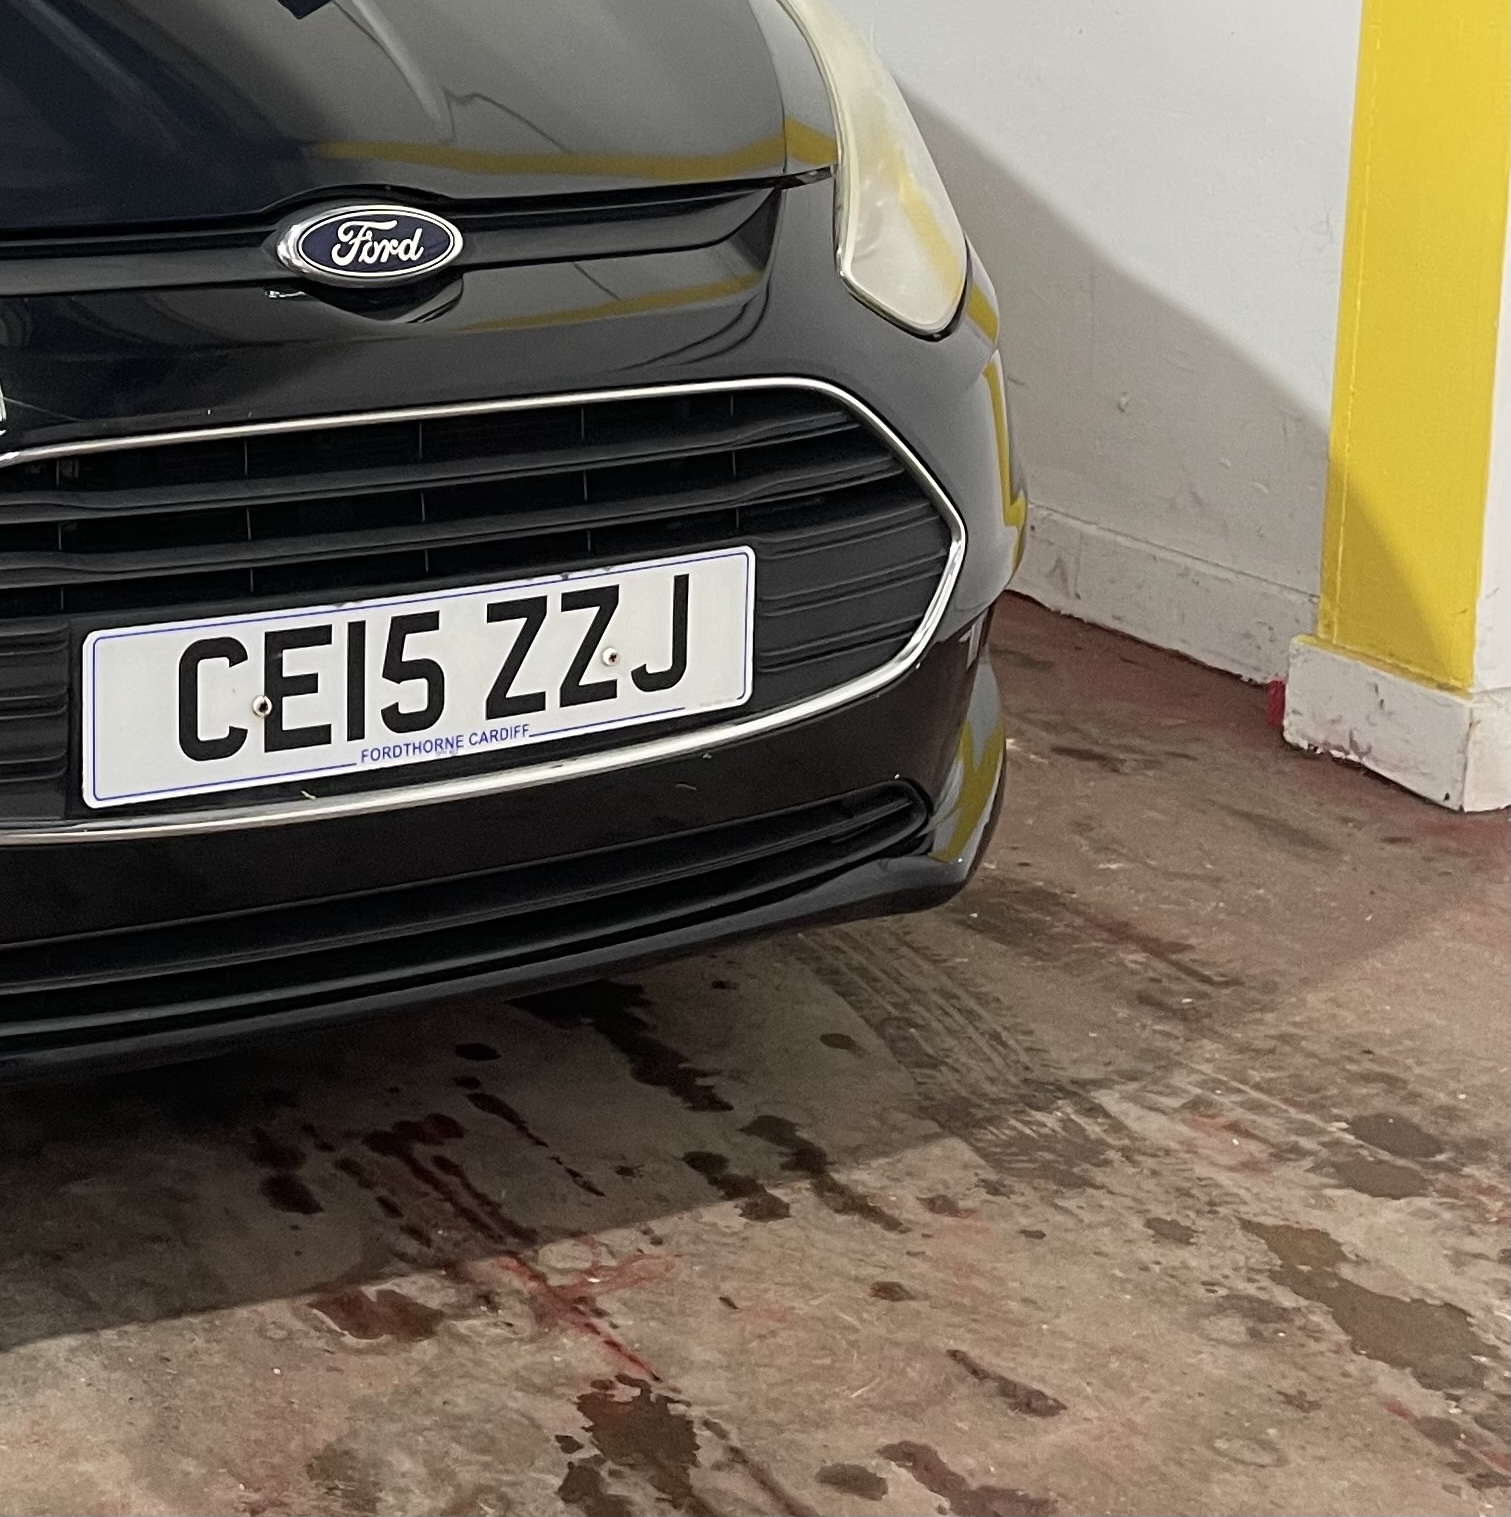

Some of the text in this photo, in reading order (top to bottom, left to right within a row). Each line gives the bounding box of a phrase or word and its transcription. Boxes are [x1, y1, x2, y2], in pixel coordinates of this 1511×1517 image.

[330, 218, 426, 264] Ford
[178, 573, 689, 762] CE15 ZZJ
[361, 724, 530, 762] FORDTHORNE CARDIFF
